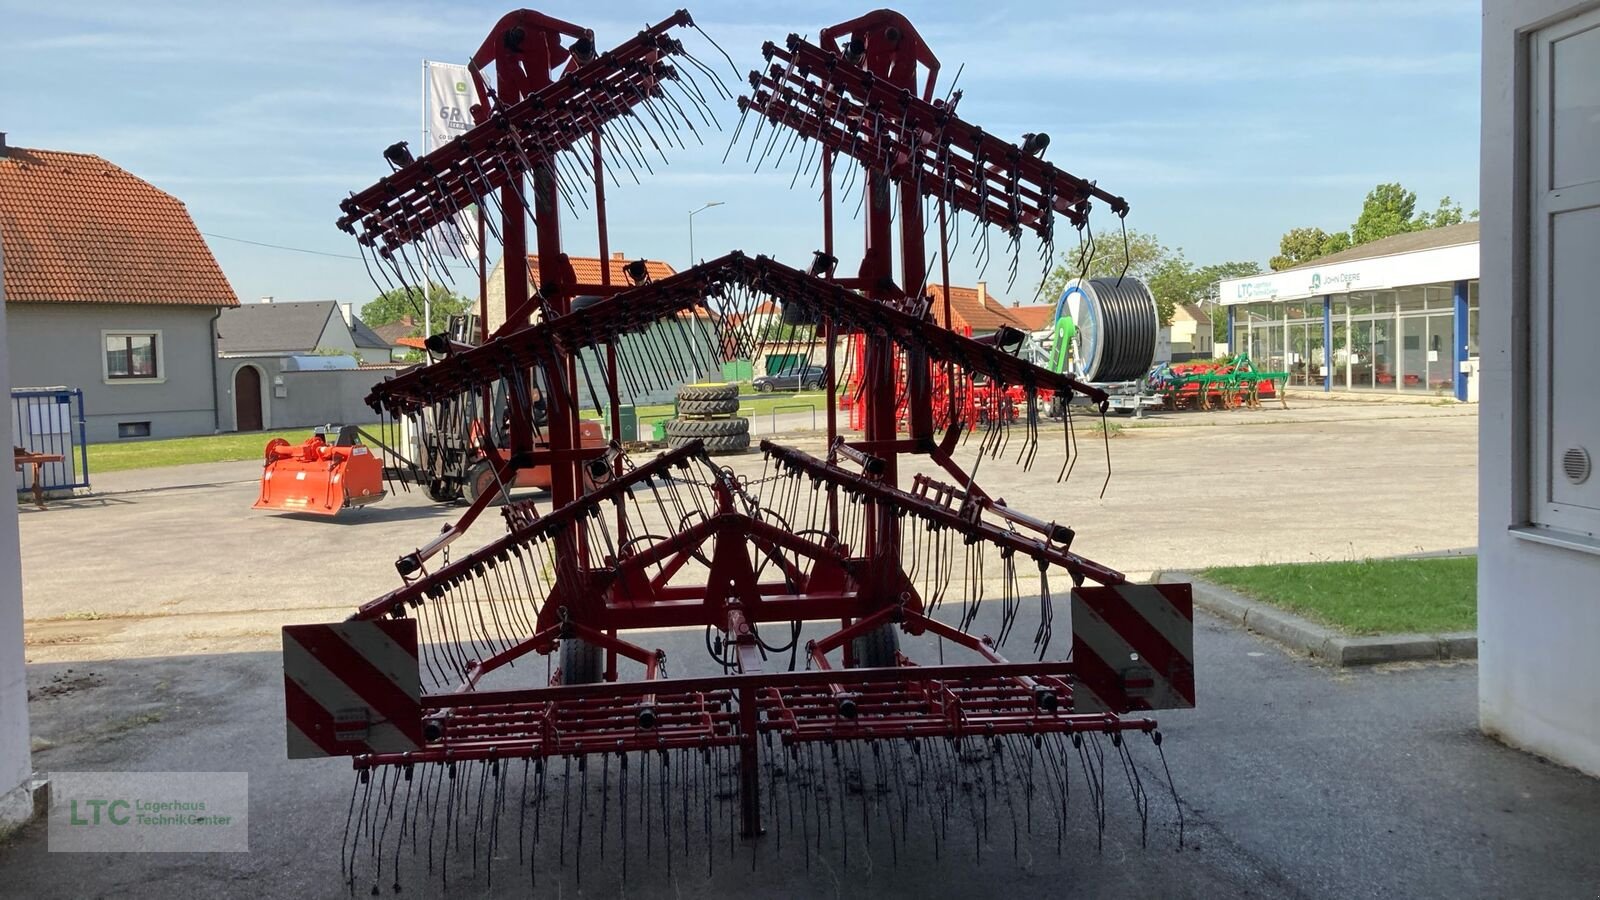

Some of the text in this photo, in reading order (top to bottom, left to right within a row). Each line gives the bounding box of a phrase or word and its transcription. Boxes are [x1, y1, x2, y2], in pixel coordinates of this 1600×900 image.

[440, 106, 461, 121] 6R
[1323, 273, 1361, 285] JOHN DEERE
[1237, 283, 1253, 299] LTC
